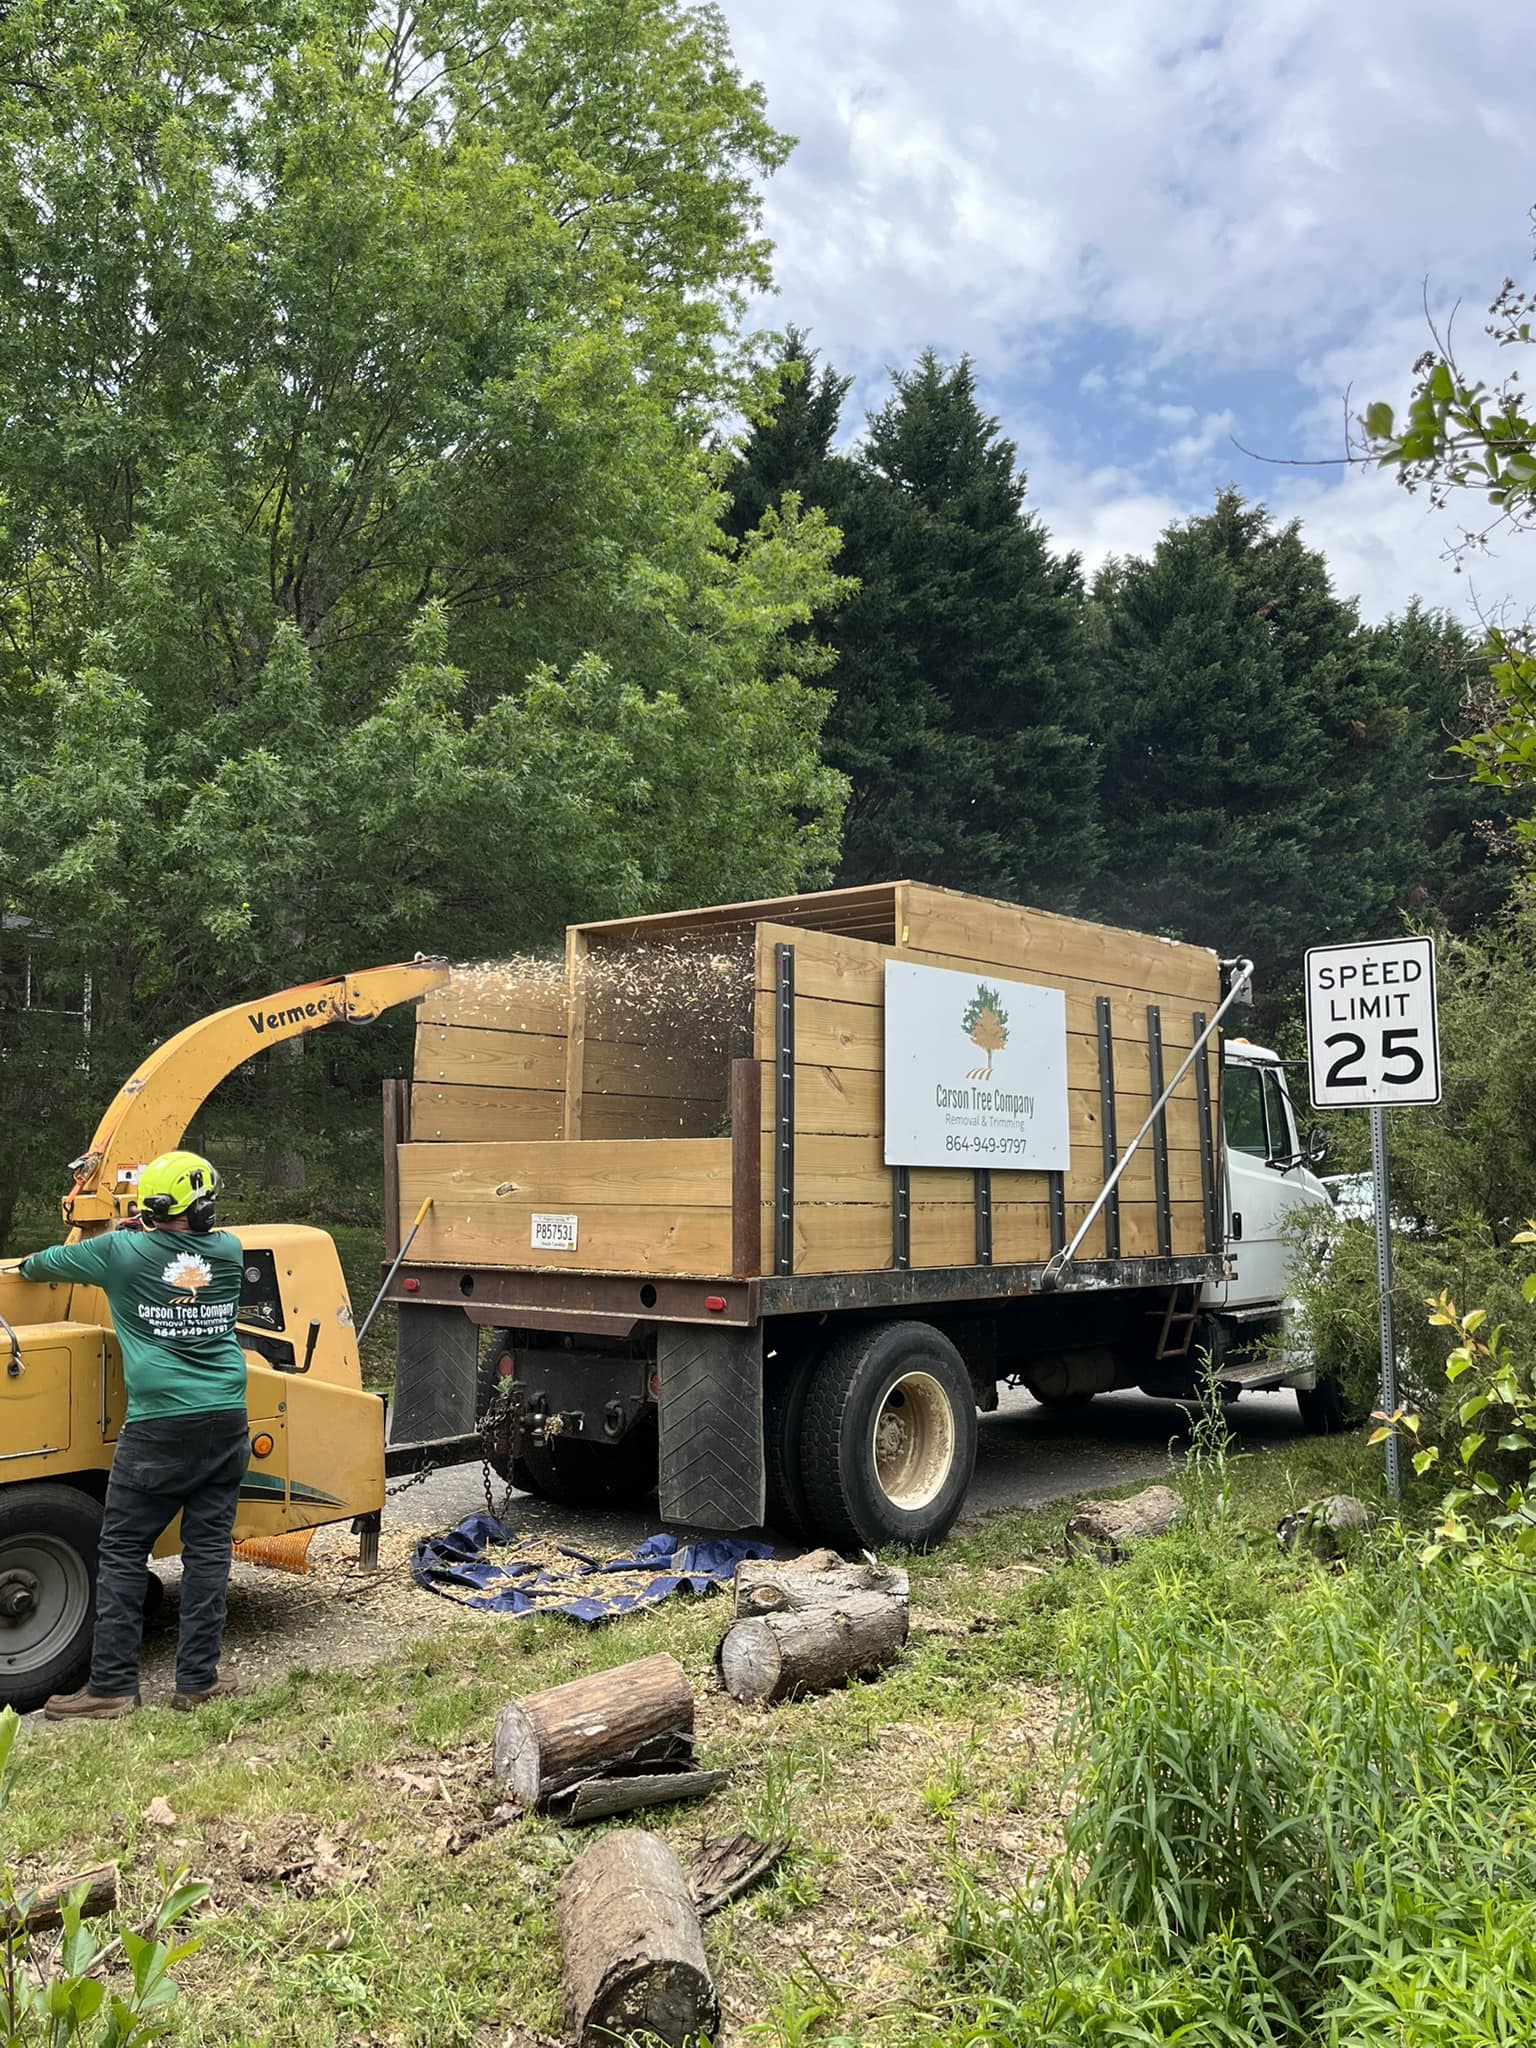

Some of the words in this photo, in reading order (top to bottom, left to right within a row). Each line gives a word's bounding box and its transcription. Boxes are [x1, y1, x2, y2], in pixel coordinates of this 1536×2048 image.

[1318, 959, 1422, 990] SPEED
[247, 996, 335, 1034] Vermee
[1330, 993, 1411, 1022] LIMIT
[1323, 1028, 1424, 1088] 25
[936, 1083, 969, 1110] Carson
[971, 1087, 993, 1112] Tree
[994, 1089, 1034, 1120] Company
[945, 1113, 980, 1127] Removal
[981, 1117, 988, 1128] &
[989, 1116, 1025, 1133] Trimming
[945, 1135, 1027, 1155] 864-949-9797
[536, 1223, 574, 1241] P857531
[138, 1303, 174, 1320] Carson
[175, 1306, 199, 1320] Tree
[200, 1302, 234, 1319] Company
